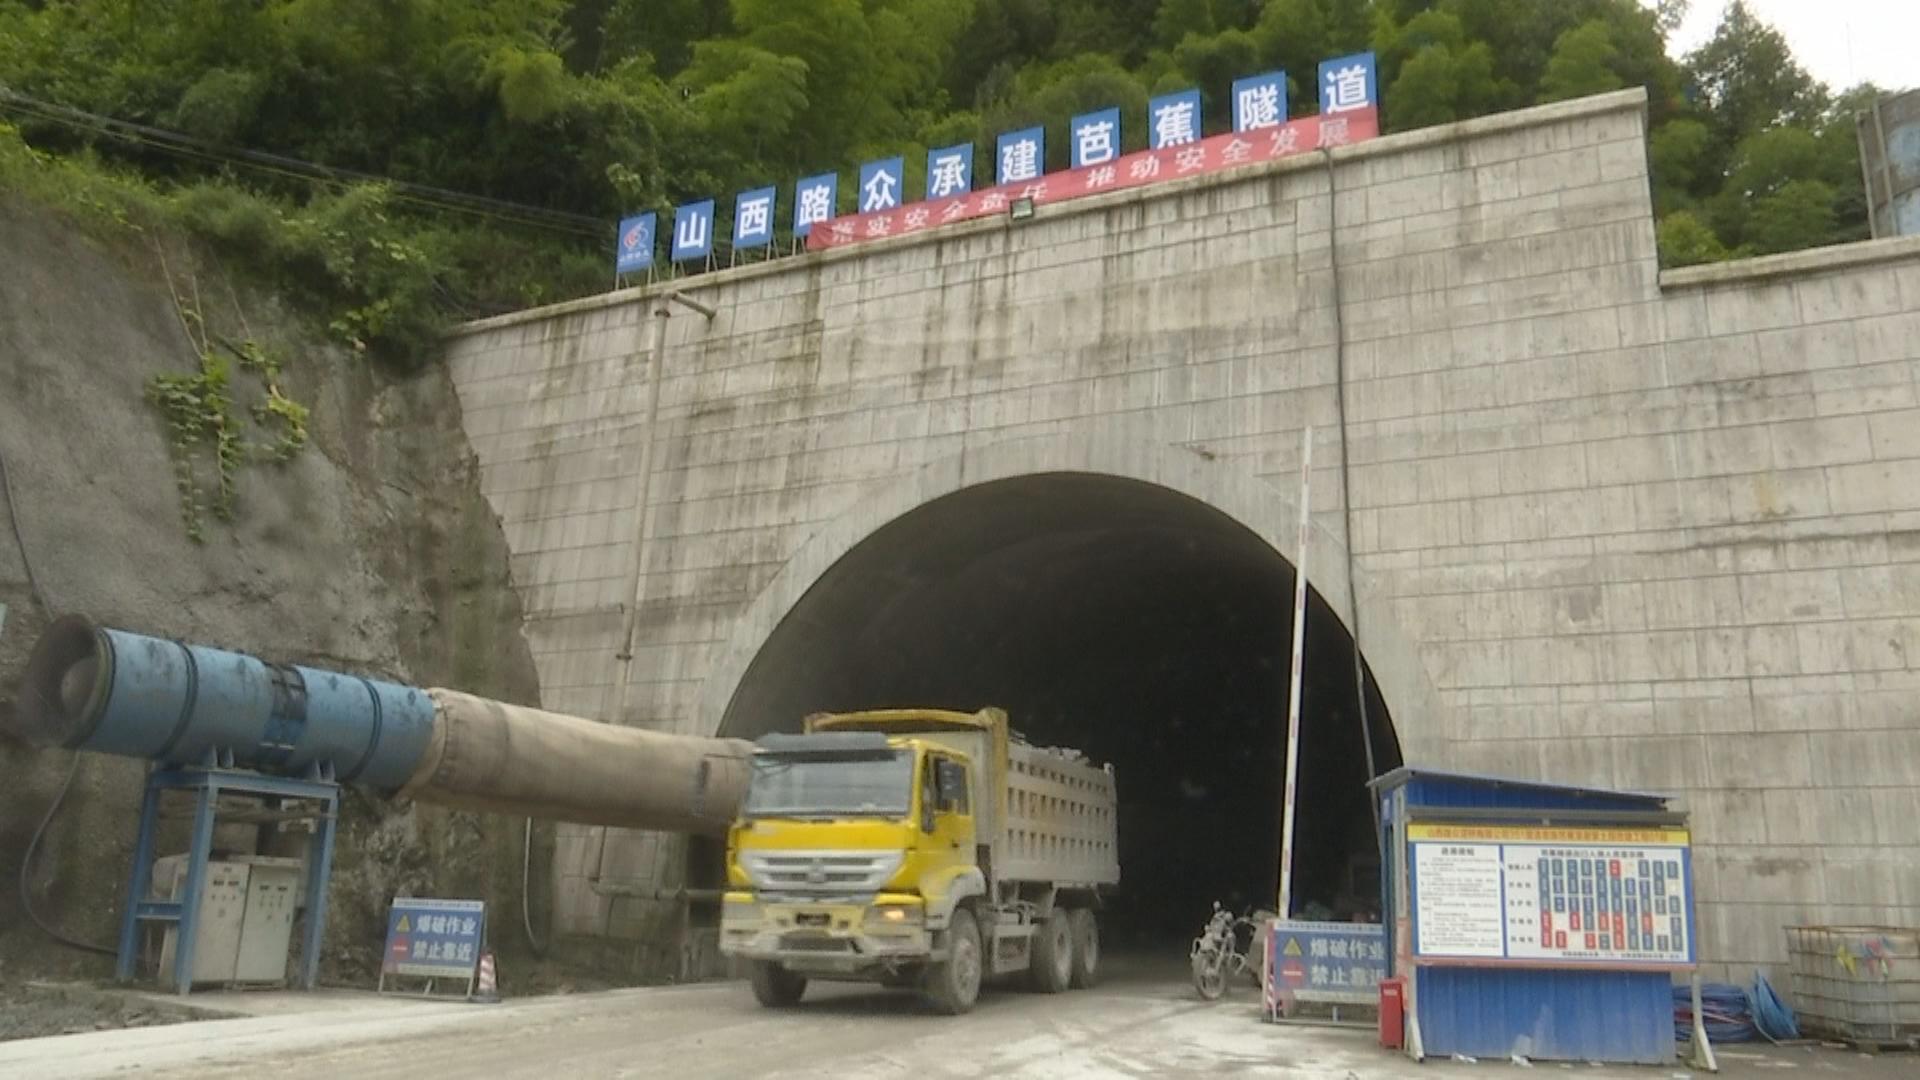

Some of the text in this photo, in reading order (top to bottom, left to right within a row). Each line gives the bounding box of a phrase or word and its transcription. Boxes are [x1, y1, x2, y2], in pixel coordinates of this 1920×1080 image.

[678, 64, 1369, 250] 山西路众承建芭蕉隧道
[1085, 118, 1349, 189] 推动安全发展
[416, 914, 477, 935] 爆破作业
[412, 940, 473, 962] 禁止靠近
[1310, 937, 1385, 960] 爆破作业
